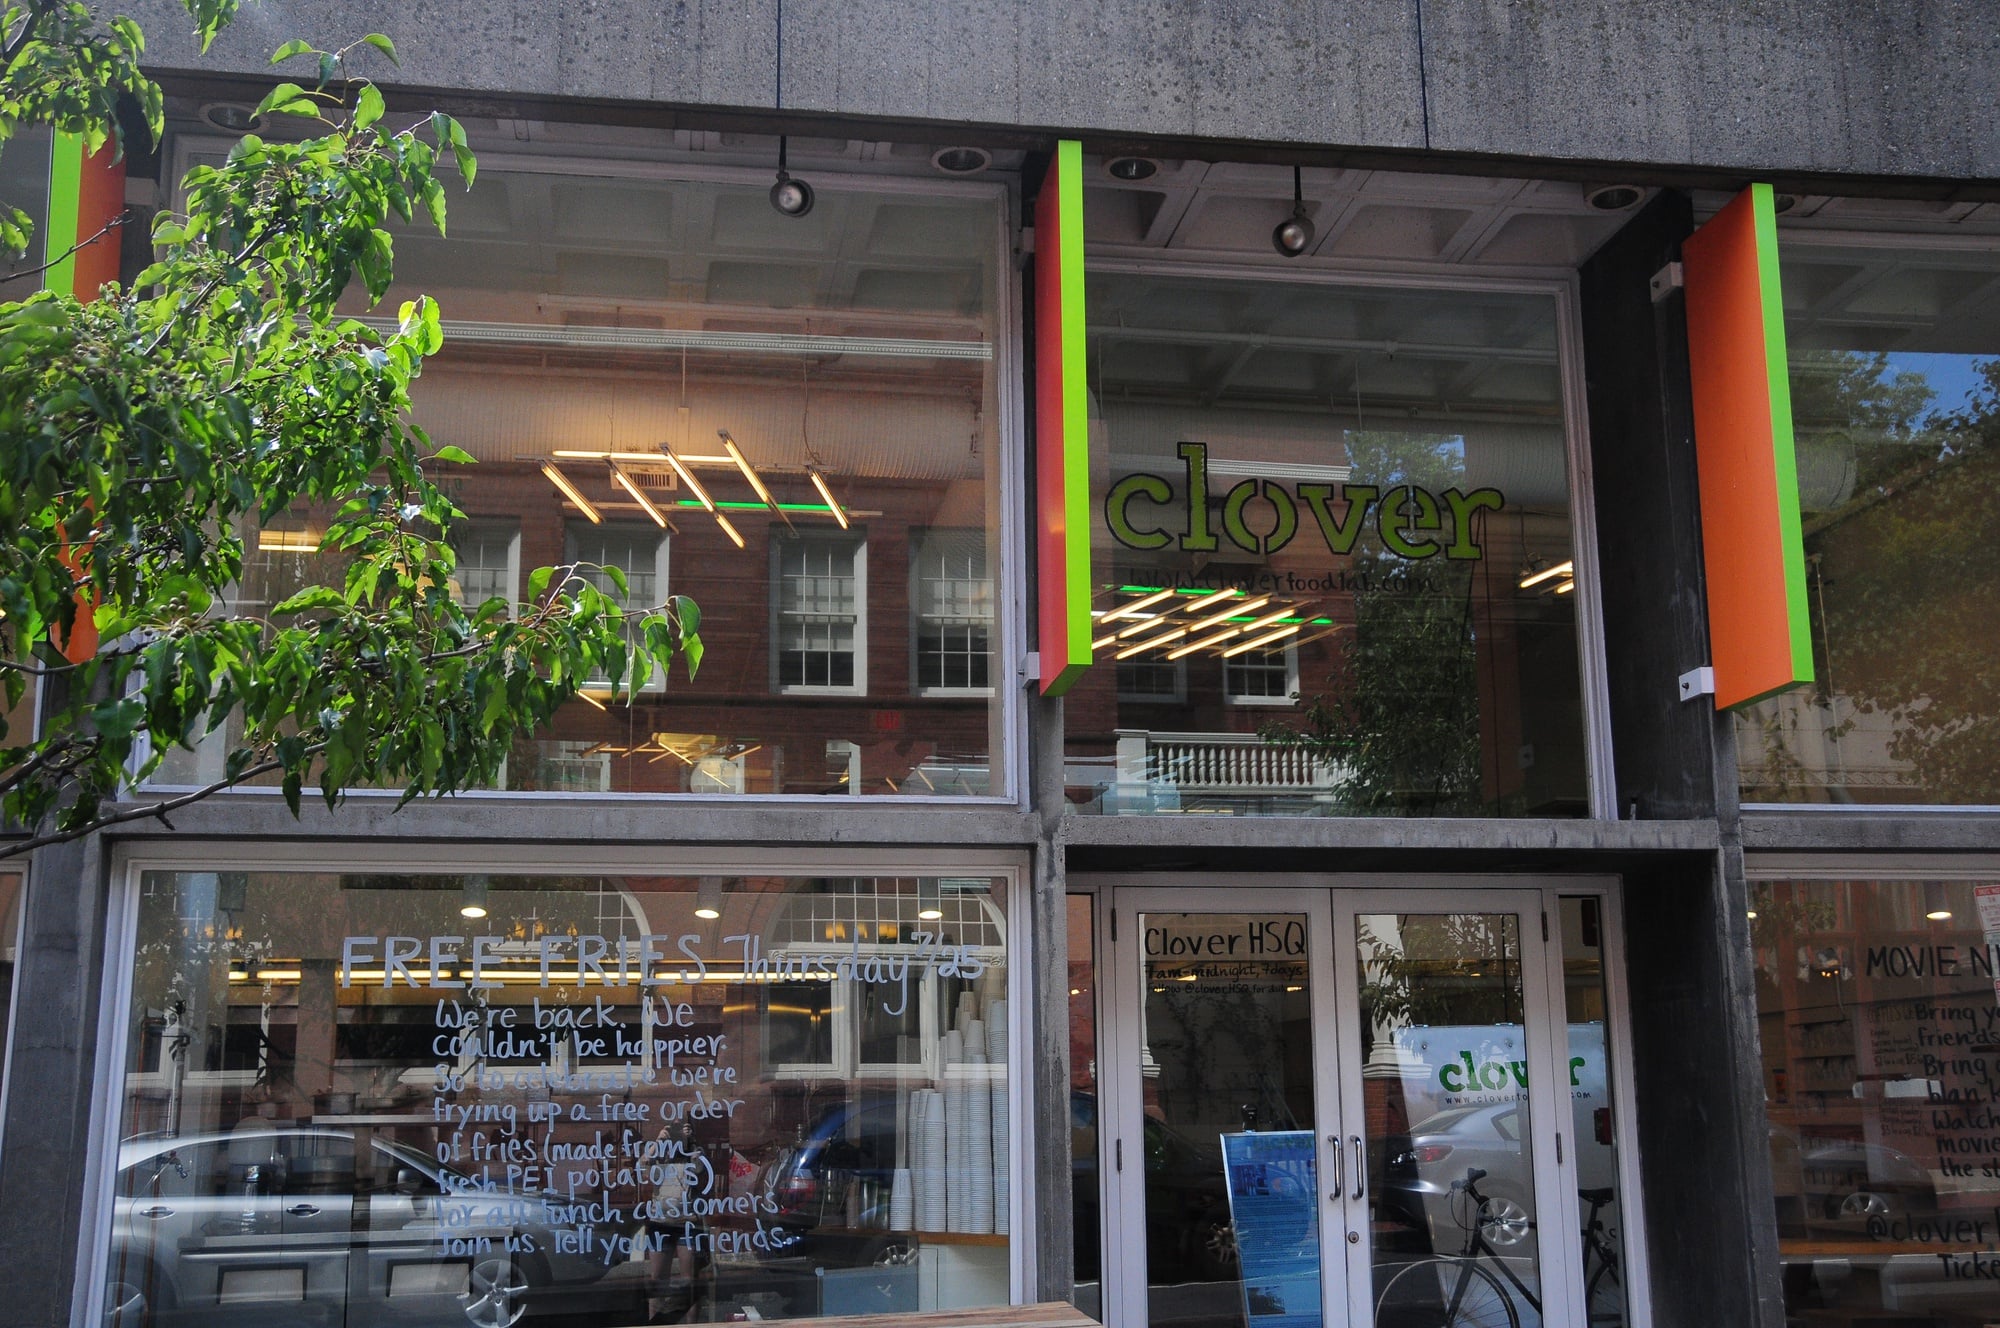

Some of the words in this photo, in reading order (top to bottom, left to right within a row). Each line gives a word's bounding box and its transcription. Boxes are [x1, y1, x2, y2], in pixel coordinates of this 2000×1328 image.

[1105, 442, 1504, 560] clover
[342, 937, 505, 988] FREE
[540, 935, 706, 988] FRIES
[723, 927, 909, 1016] Thursday
[911, 931, 983, 981] 7/25
[1866, 946, 1962, 977] MOVIE
[435, 998, 518, 1028] We're
[534, 995, 626, 1030] back.
[641, 996, 694, 1028] We
[1915, 1003, 1978, 1035] Bring
[432, 1030, 558, 1058] couldn't
[573, 1029, 608, 1057] be
[616, 1030, 727, 1068] happier.
[433, 1063, 465, 1092] So
[477, 1062, 504, 1091] to
[513, 1060, 659, 1091] celebrate
[671, 1059, 738, 1087] we're
[1439, 1050, 1586, 1093] clovr
[1923, 1053, 1988, 1085] Bring
[432, 1097, 517, 1135] frying
[528, 1102, 562, 1133] up
[570, 1103, 591, 1121] a
[597, 1093, 650, 1121] free
[660, 1090, 746, 1121] order
[437, 1131, 463, 1163] of
[471, 1131, 538, 1163] fries
[543, 1130, 617, 1166] (made
[621, 1128, 702, 1159] from
[1939, 1155, 1975, 1177] the
[506, 1163, 559, 1195] PEI
[567, 1155, 714, 1200] potatoes)
[486, 1199, 529, 1226] all
[540, 1190, 625, 1225] lunch
[437, 1231, 493, 1257] Join
[549, 1226, 595, 1255] Tell
[600, 1231, 671, 1266] your
[679, 1221, 793, 1256] friends.
